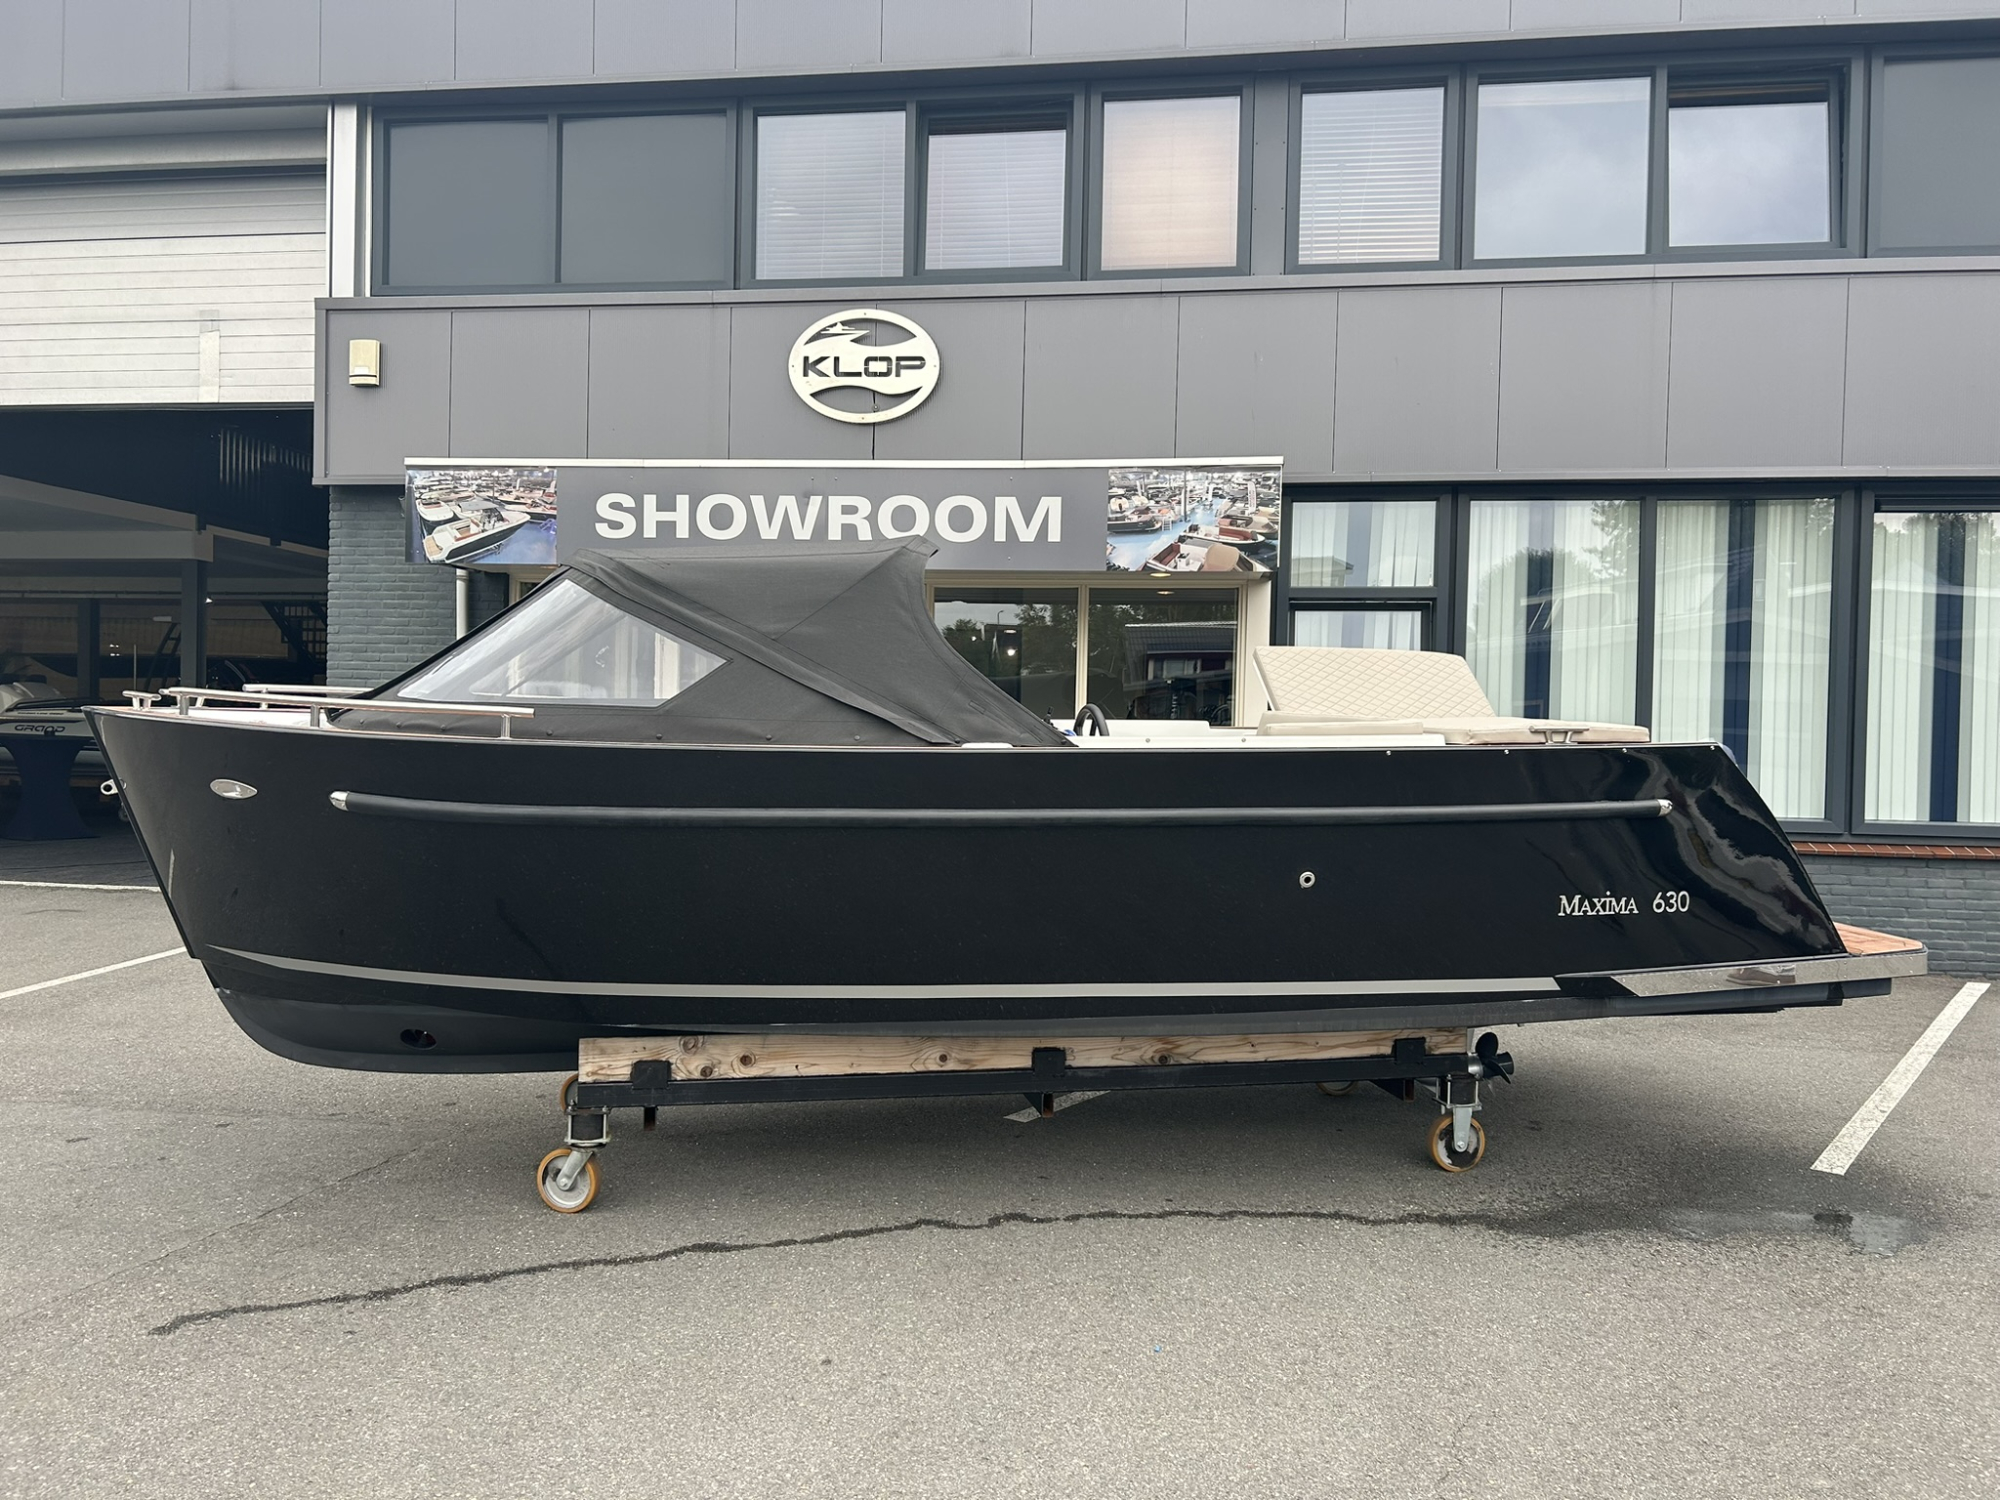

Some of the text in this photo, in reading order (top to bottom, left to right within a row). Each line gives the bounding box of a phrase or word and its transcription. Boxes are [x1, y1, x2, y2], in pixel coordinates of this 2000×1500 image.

[802, 355, 927, 378] KLOP
[594, 492, 1063, 543] SHOWROOM
[1557, 890, 1691, 917] MAXIMA 630
